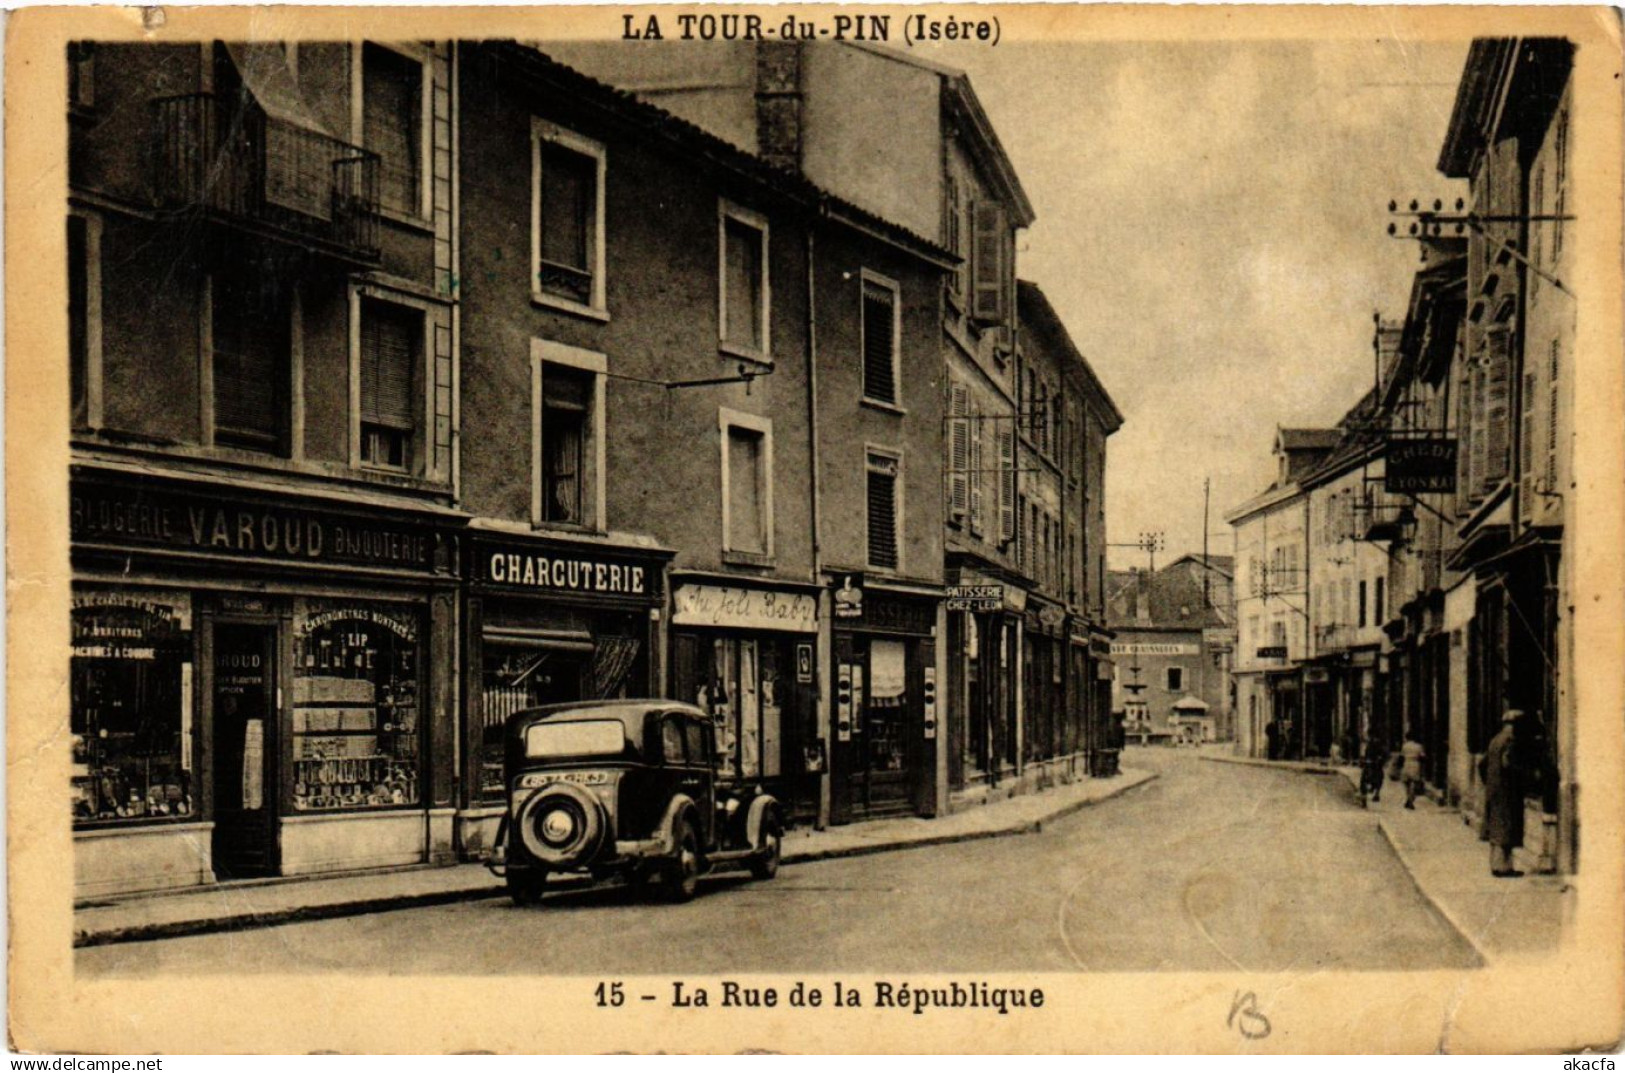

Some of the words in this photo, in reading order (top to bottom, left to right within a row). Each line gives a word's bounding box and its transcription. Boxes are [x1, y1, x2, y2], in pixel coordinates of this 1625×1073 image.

[188, 506, 324, 558] VAROUD
[334, 525, 428, 564] BIJOUTERIE
[490, 553, 645, 593] CHARCUTERIE
[759, 590, 812, 620] Baby
[946, 586, 1003, 598] PATISSERIE
[347, 632, 369, 648] LIP
